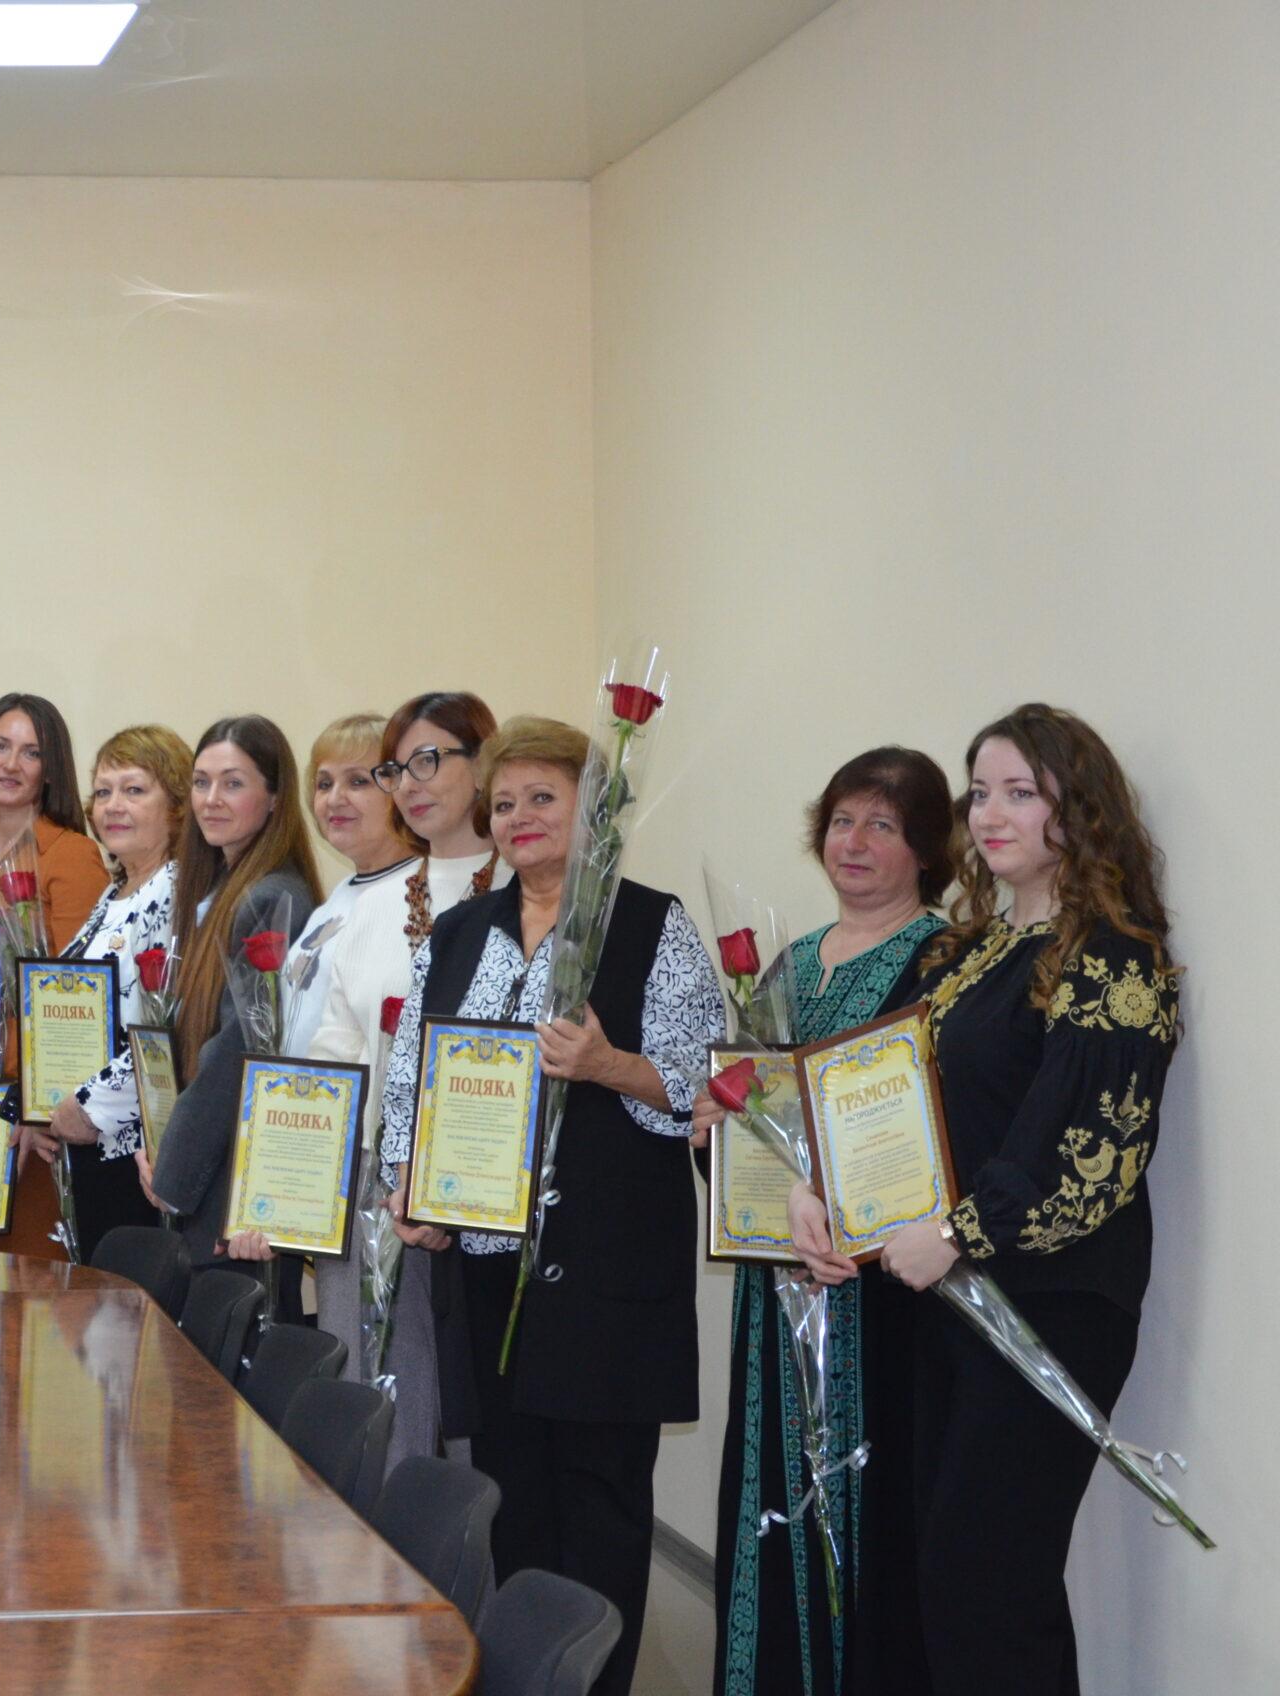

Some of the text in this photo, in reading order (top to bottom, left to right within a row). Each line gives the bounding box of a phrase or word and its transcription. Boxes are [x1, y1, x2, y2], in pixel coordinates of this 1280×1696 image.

[43, 1004, 96, 1021] ПОДЯКА
[448, 1076, 516, 1098] ПОДЯКА
[835, 1072, 912, 1115] ГРАМОТА
[265, 1109, 333, 1132] ПОДЯКА
